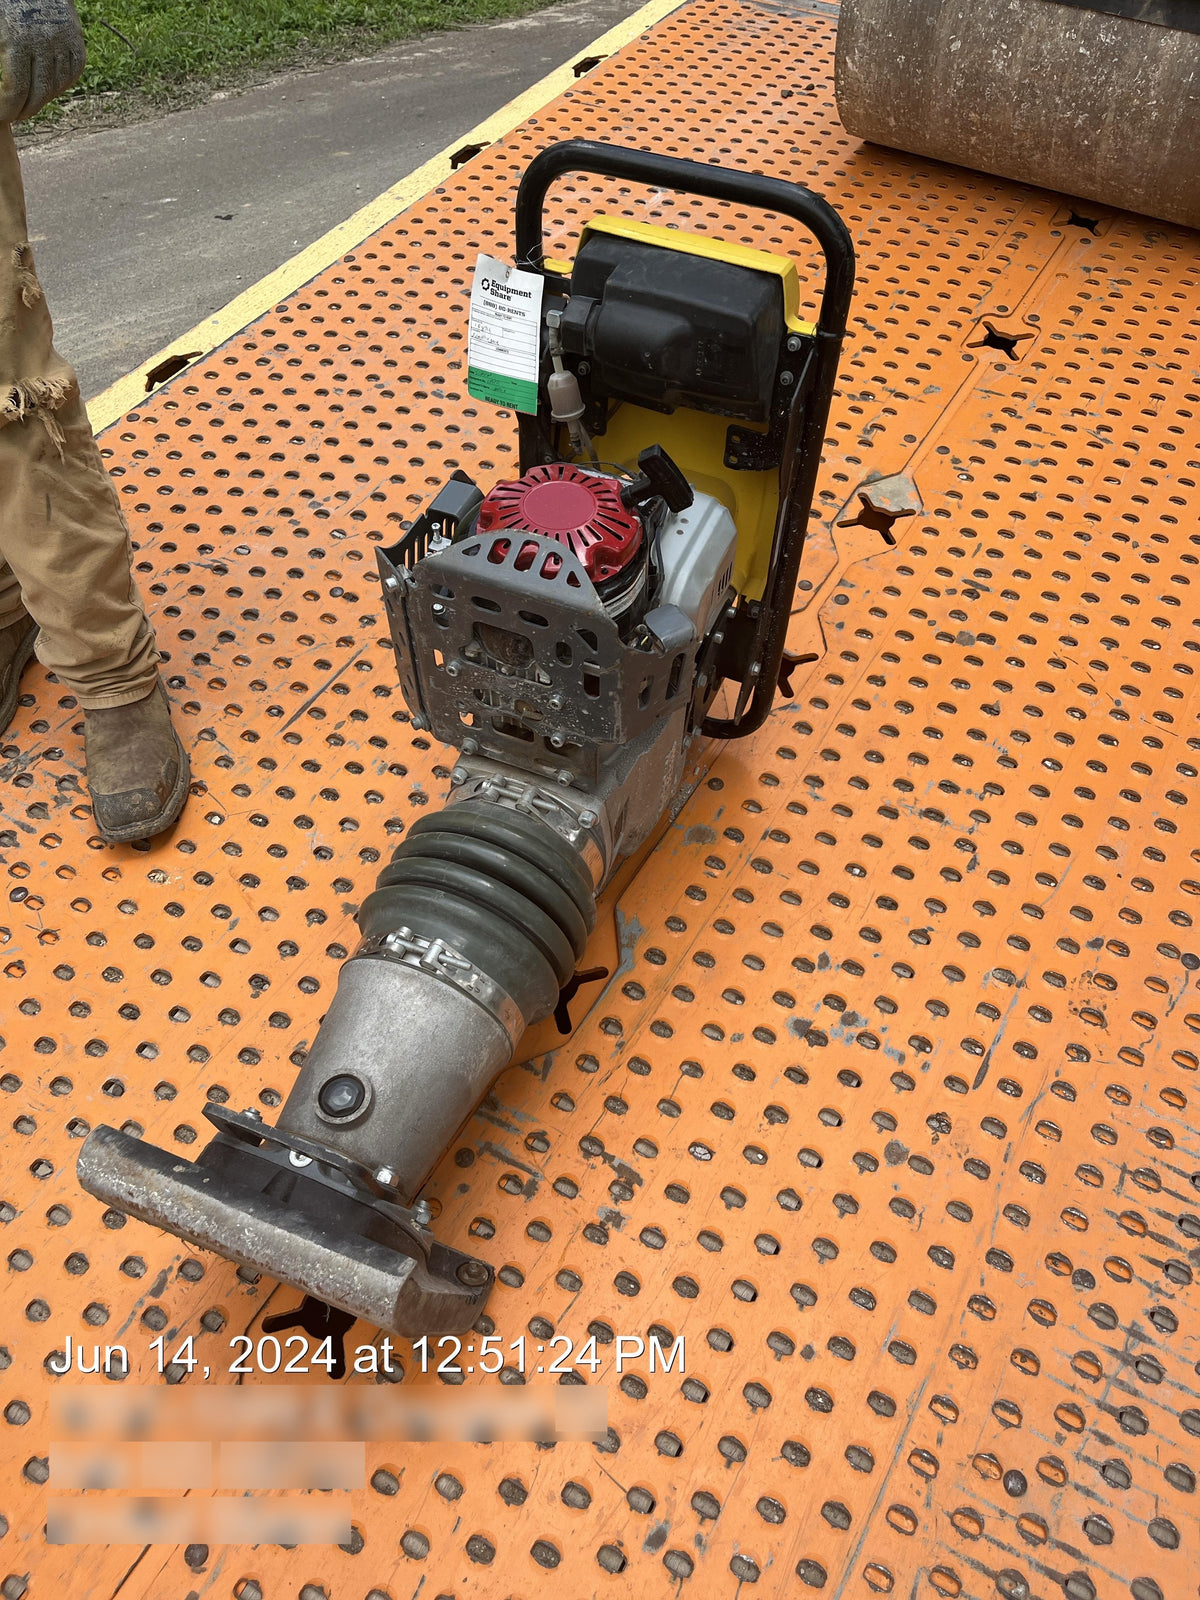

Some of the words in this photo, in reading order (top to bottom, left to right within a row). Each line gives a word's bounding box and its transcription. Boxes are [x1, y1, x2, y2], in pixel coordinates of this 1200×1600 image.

[490, 287, 512, 301] Share
[491, 279, 532, 299] Equipment
[506, 402, 518, 410] RENT
